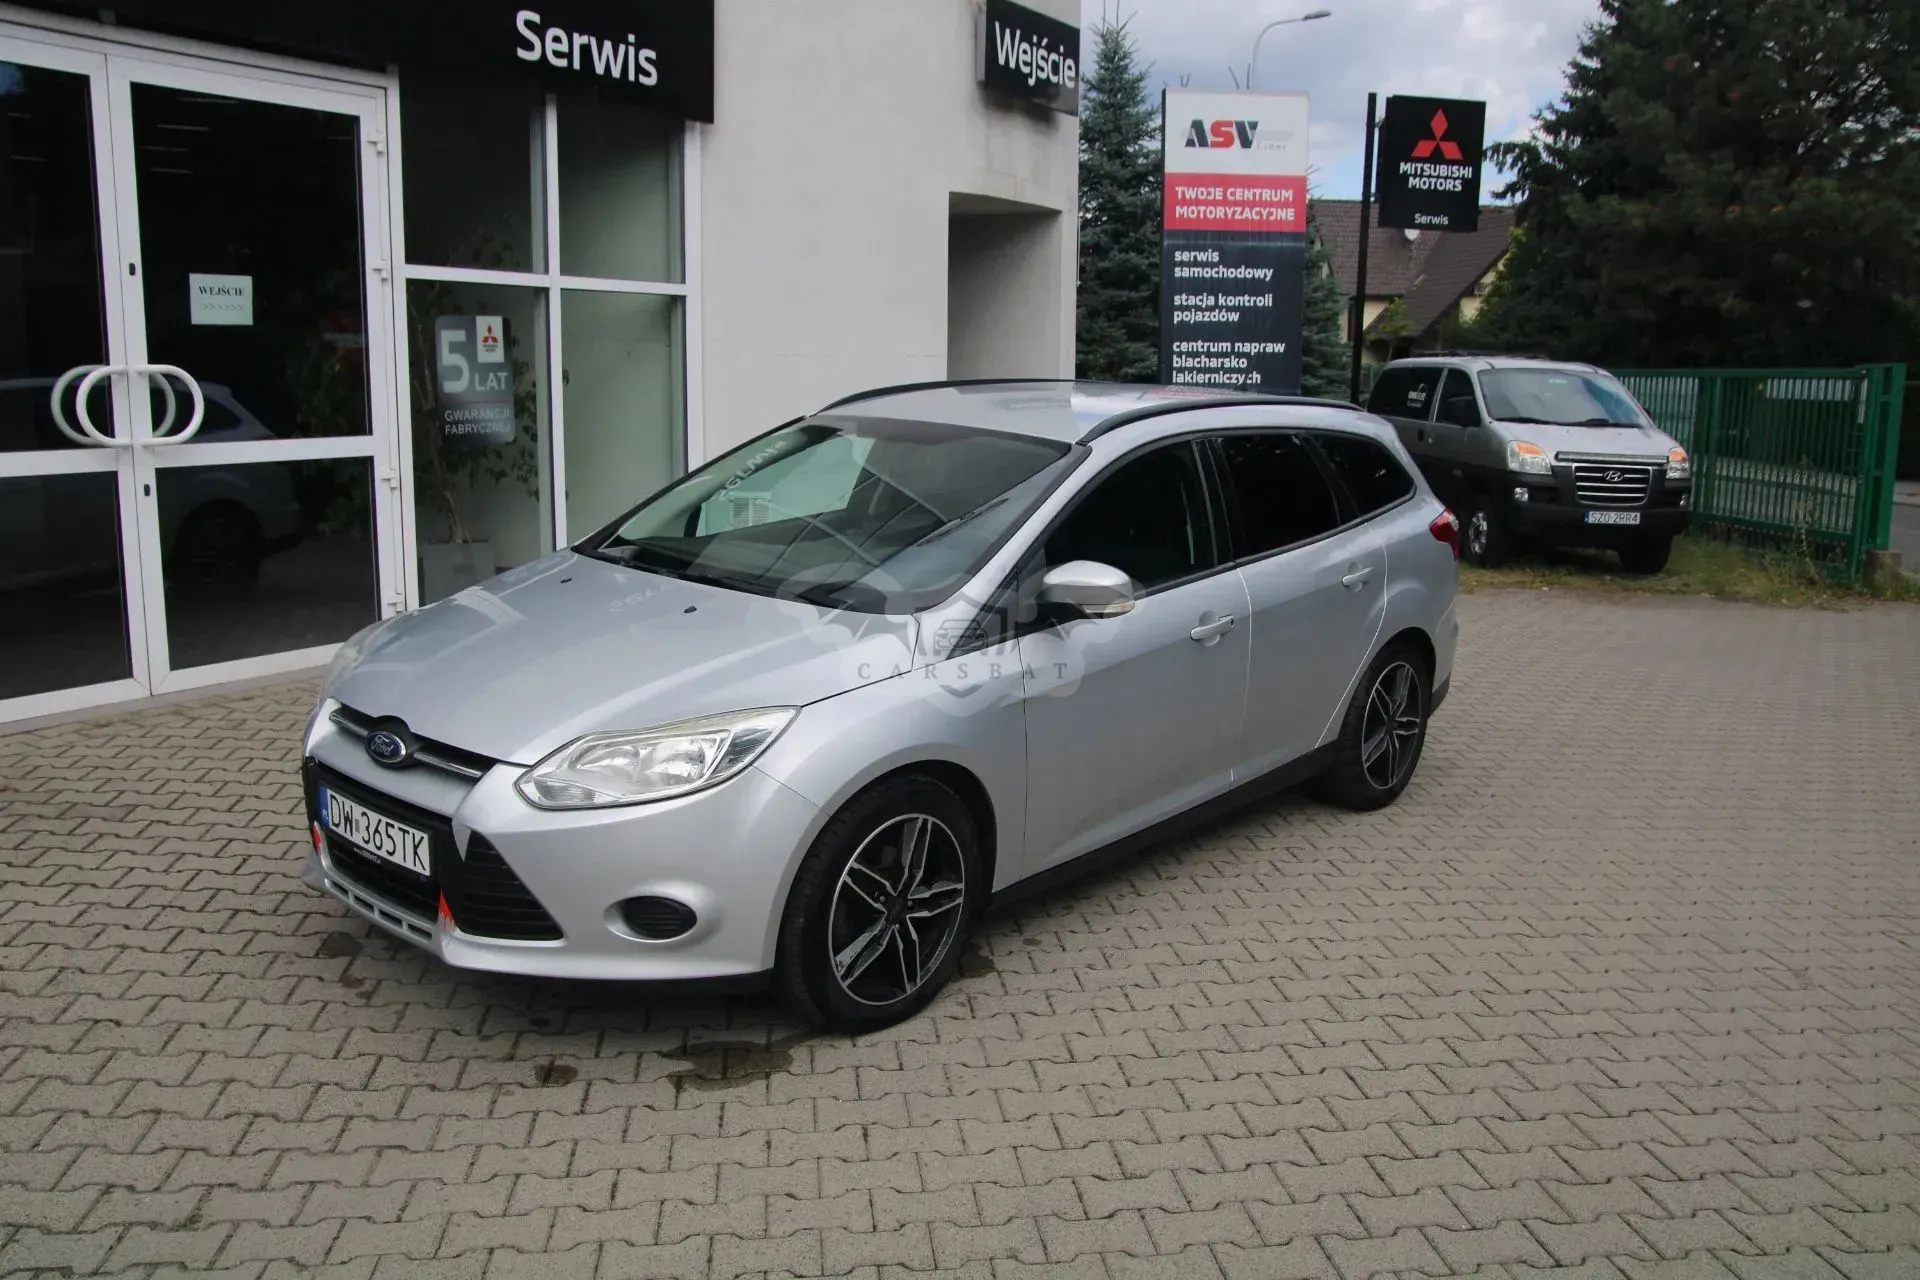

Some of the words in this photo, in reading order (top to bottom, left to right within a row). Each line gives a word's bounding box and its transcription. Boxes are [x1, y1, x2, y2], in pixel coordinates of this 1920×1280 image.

[516, 10, 658, 86] Serwis
[995, 20, 1076, 88] Wejście
[1184, 119, 1259, 149] ASV
[1400, 162, 1473, 179] MITSUBISHI
[1408, 177, 1462, 191] MOTORS
[1175, 186, 1223, 200] TWOJE
[1226, 188, 1293, 202] CENTRUM
[1175, 205, 1295, 220] MOTORYZACYJNE
[1414, 213, 1449, 225] Serwis
[1174, 249, 1219, 262] serwis
[1174, 265, 1273, 281] samochodowy
[1173, 292, 1215, 308] stacja
[1218, 293, 1273, 307] kontroli
[1173, 309, 1240, 324] pojazdów
[1173, 340, 1232, 353] centrum
[1234, 342, 1286, 355] napraw
[441, 329, 470, 393] 5
[474, 372, 508, 391] LAT
[1172, 354, 1248, 368] blacharsko
[1172, 370, 1261, 385] lakierniczych
[444, 407, 510, 422] GWARANCJI
[445, 421, 511, 436] FABRYCZNEJ
[371, 735, 395, 756] Ford
[330, 794, 354, 837] DW
[361, 811, 426, 871] 365TK
